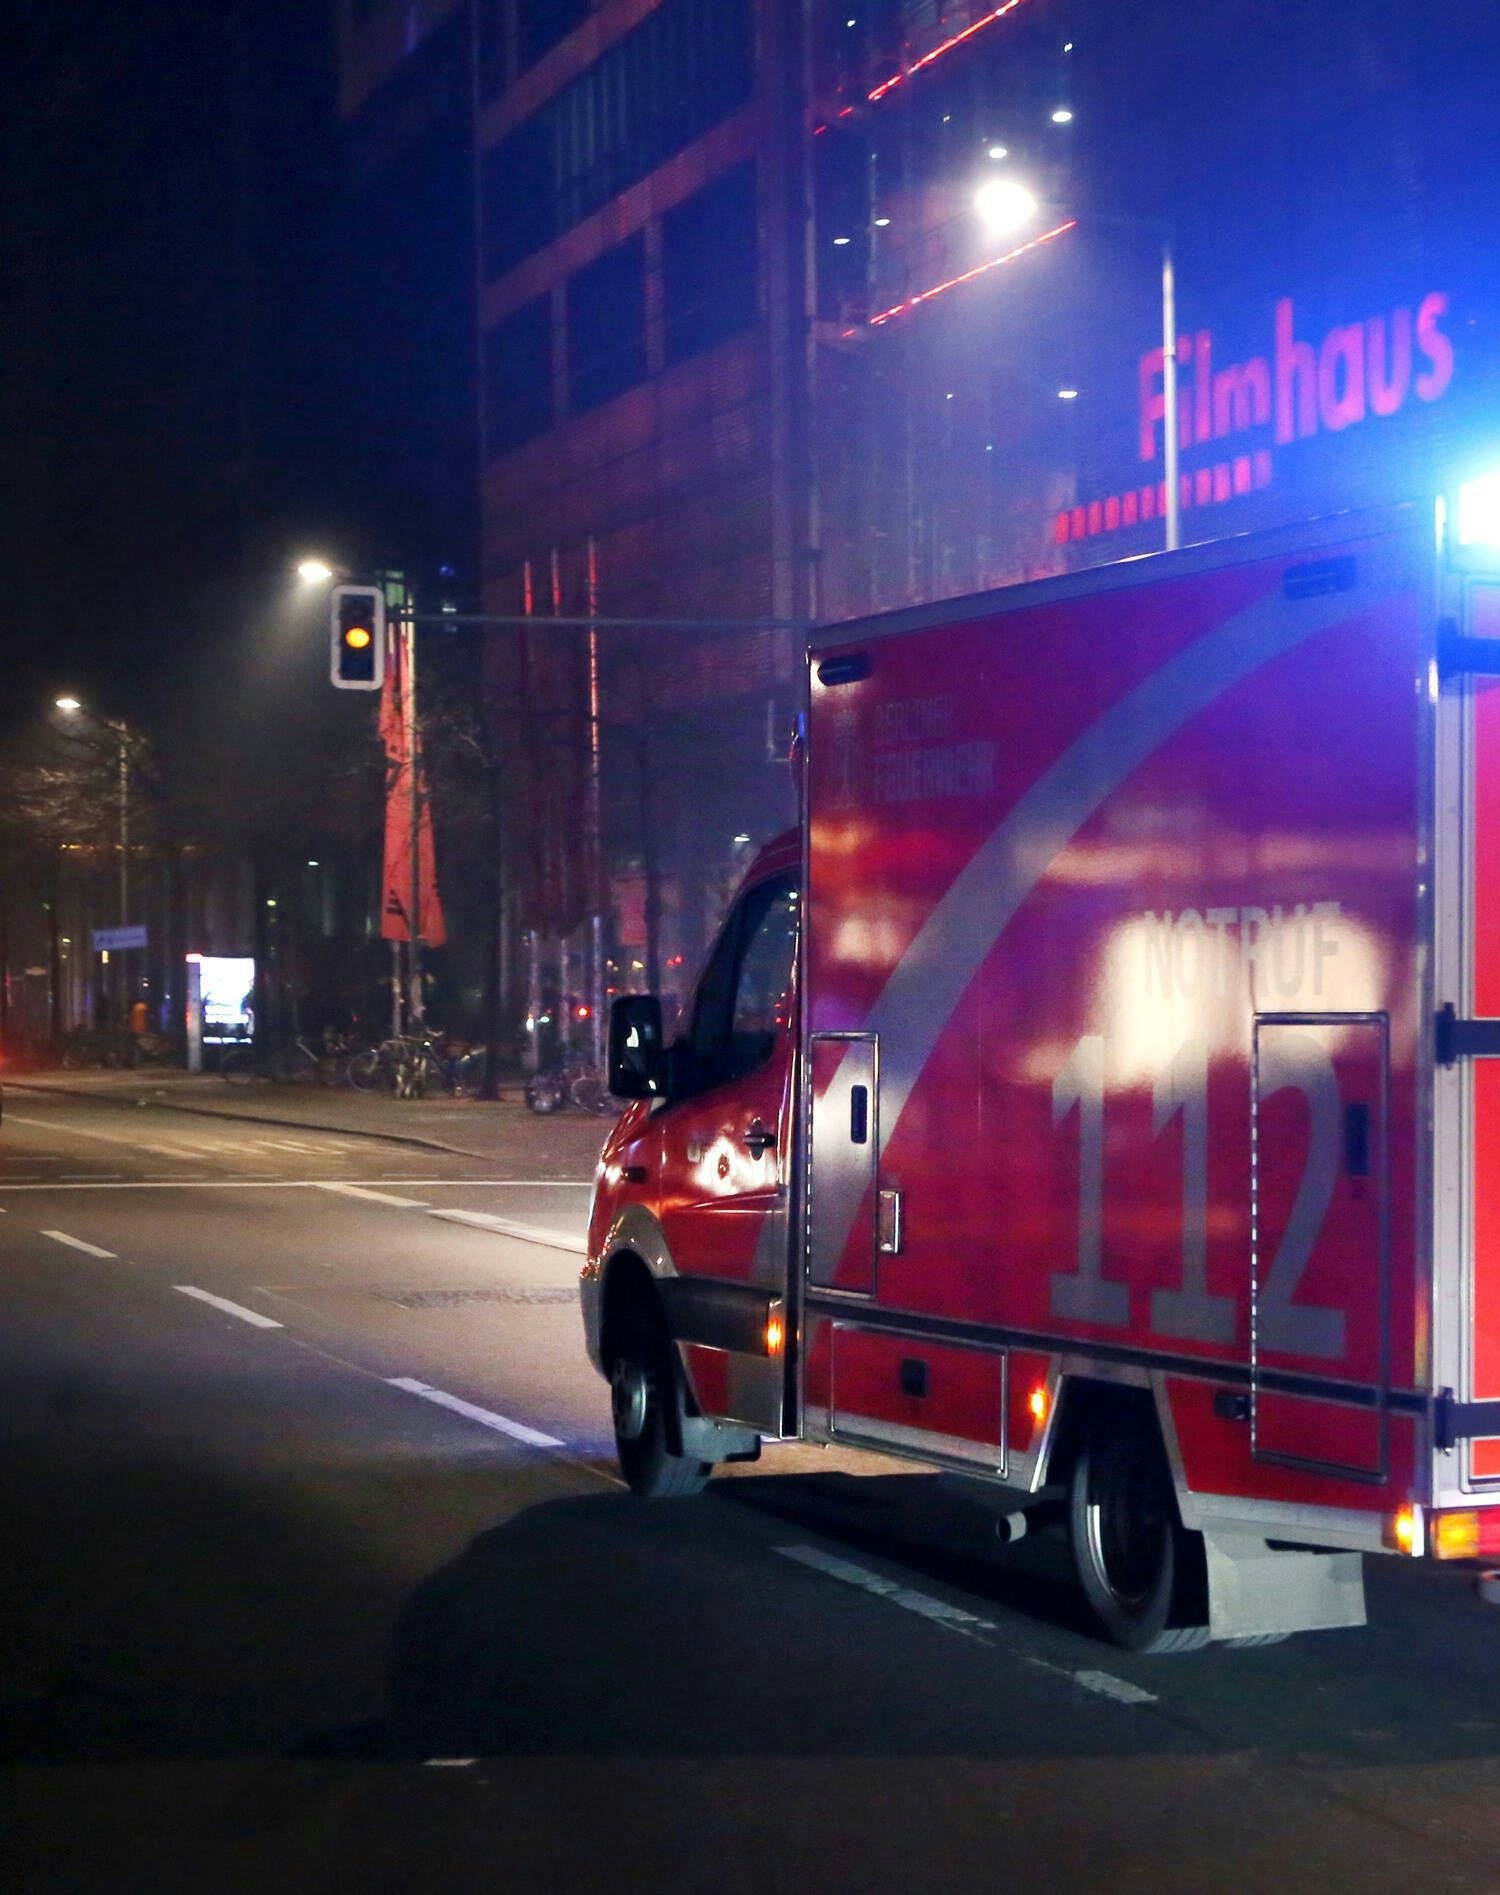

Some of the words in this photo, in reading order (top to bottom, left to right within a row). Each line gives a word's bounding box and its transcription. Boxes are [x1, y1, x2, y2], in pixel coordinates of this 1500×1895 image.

[1140, 291, 1455, 461] Filmhaus
[872, 740, 994, 802] FEUERWEHR
[1144, 900, 1341, 999] NOTRUF
[1050, 1034, 1345, 1360] 112
